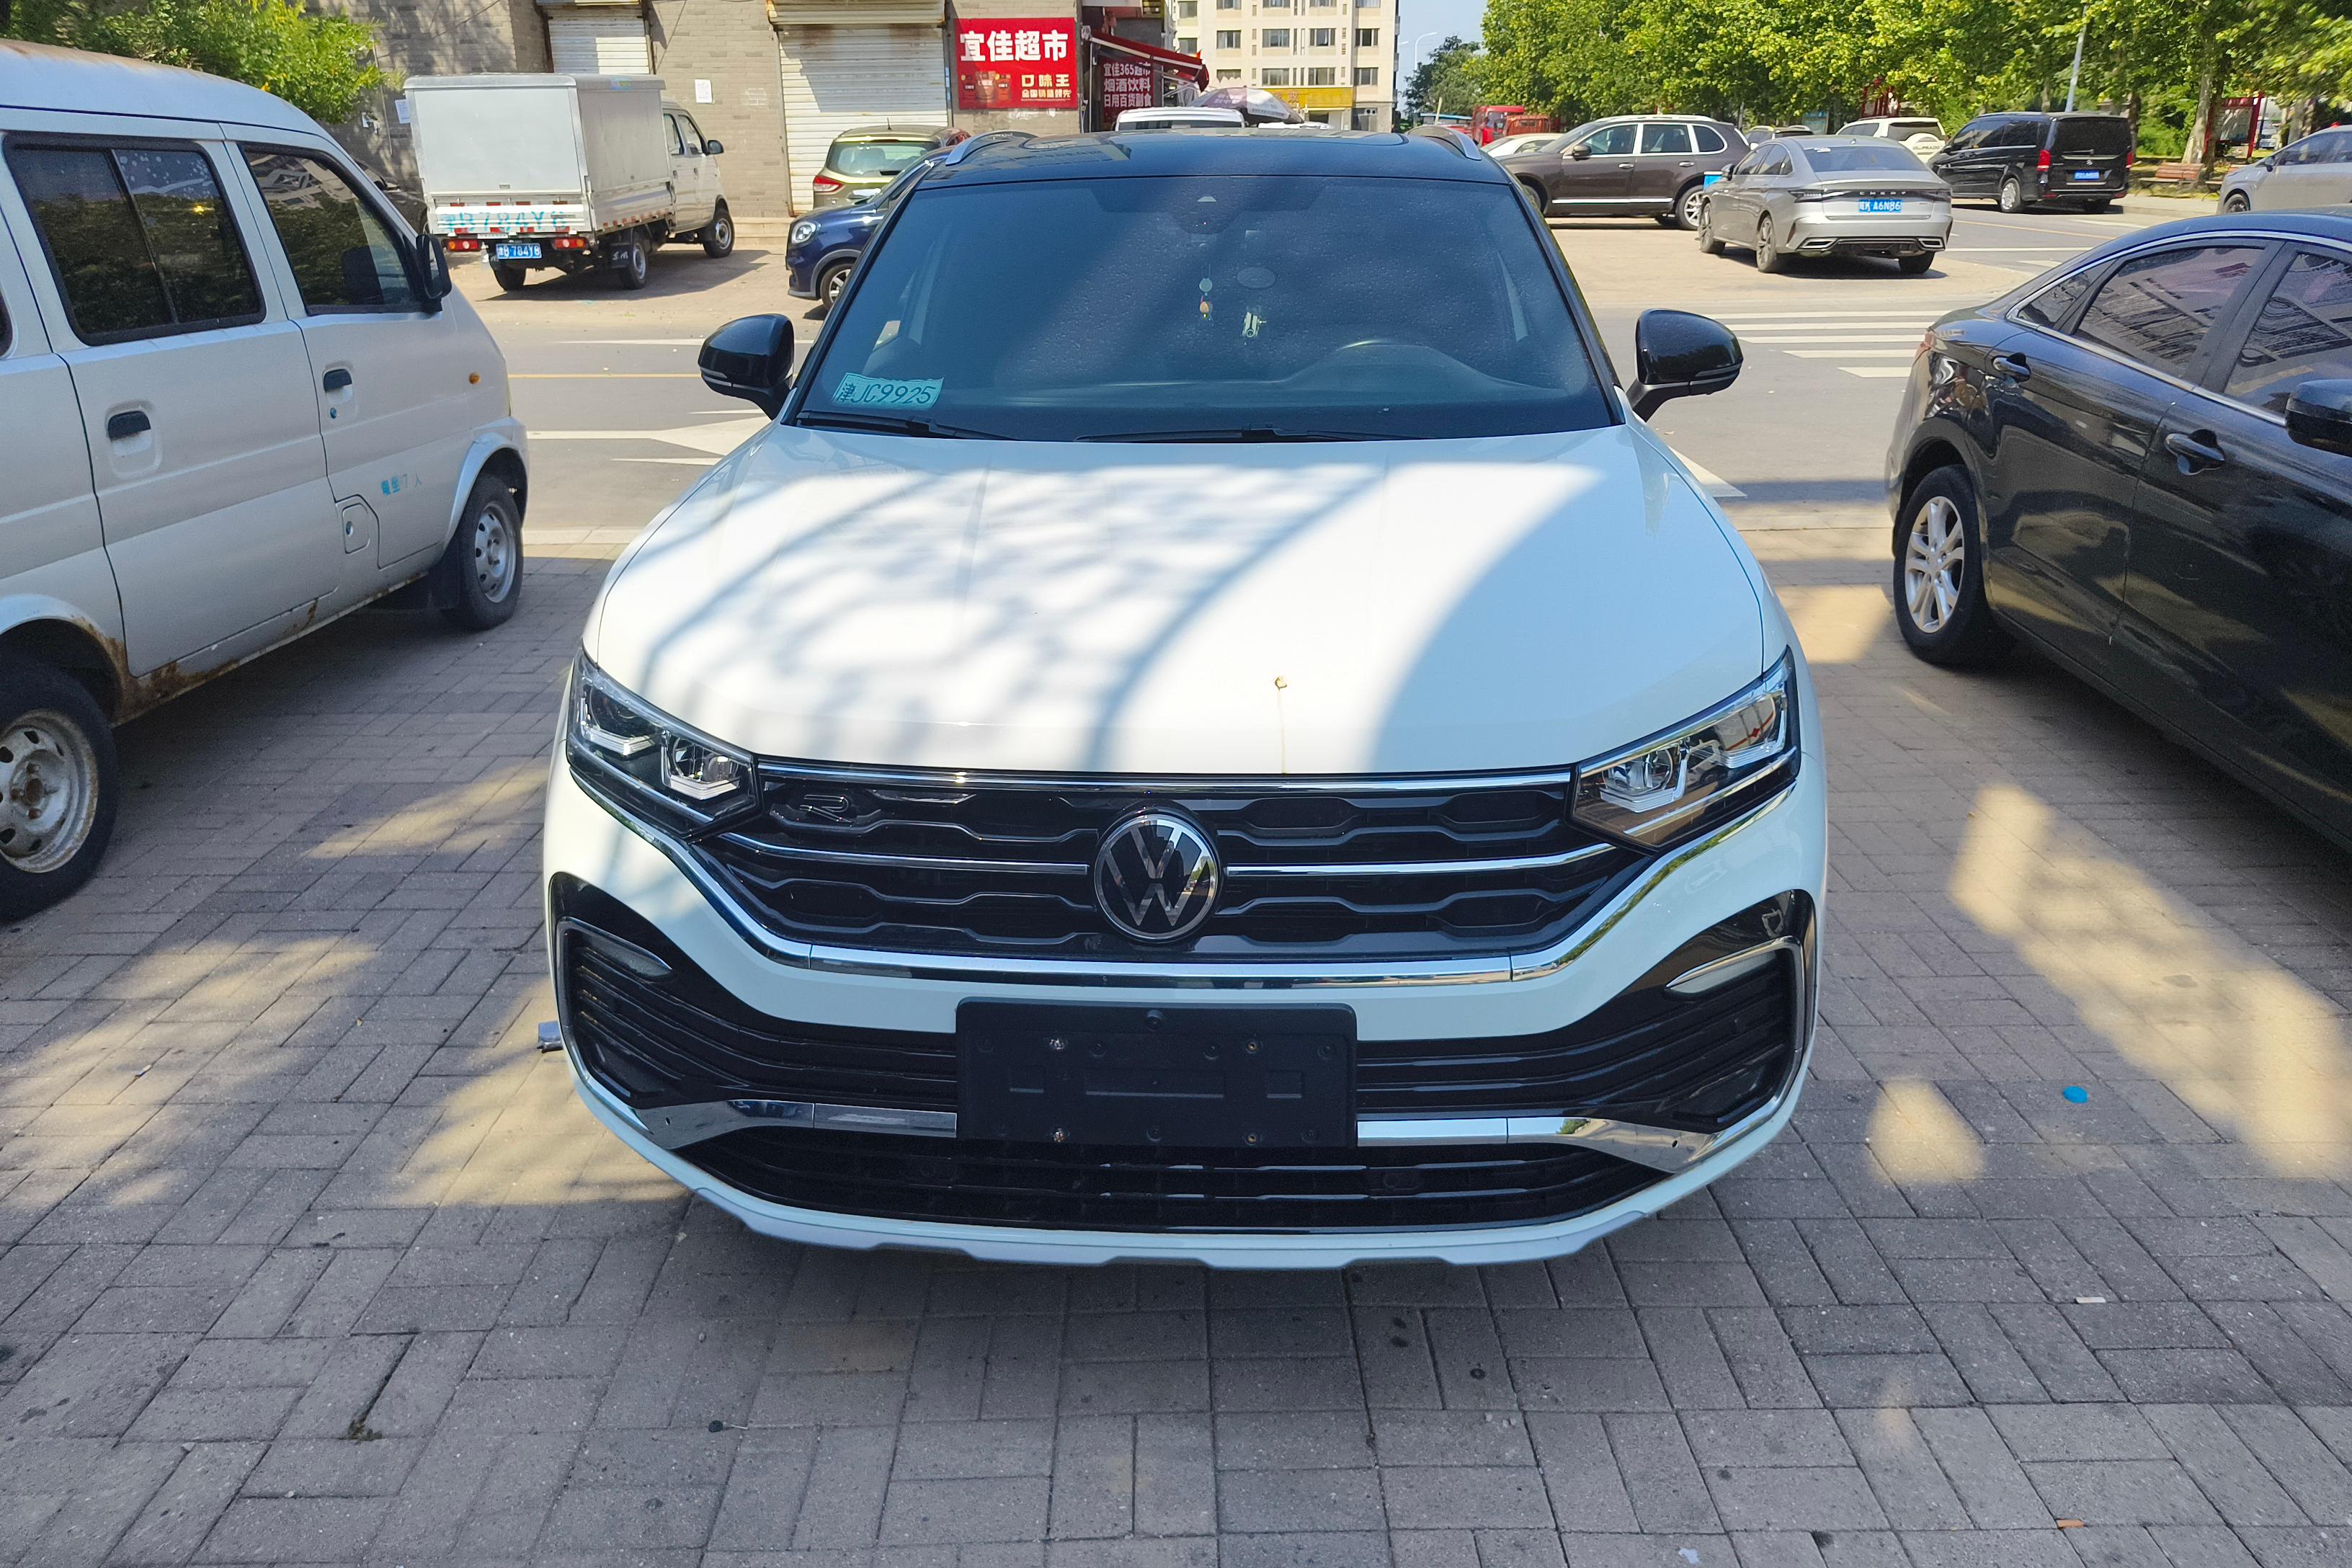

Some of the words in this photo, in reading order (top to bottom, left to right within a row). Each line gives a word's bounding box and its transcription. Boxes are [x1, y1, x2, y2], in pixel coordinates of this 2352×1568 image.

[960, 30, 1069, 61] 宜佳超市
[1021, 74, 1070, 87] 口味王
[1104, 77, 1151, 92] 烟酒饮料
[1104, 92, 1152, 107] 日用百货副食
[836, 383, 937, 404] 津JC9925
